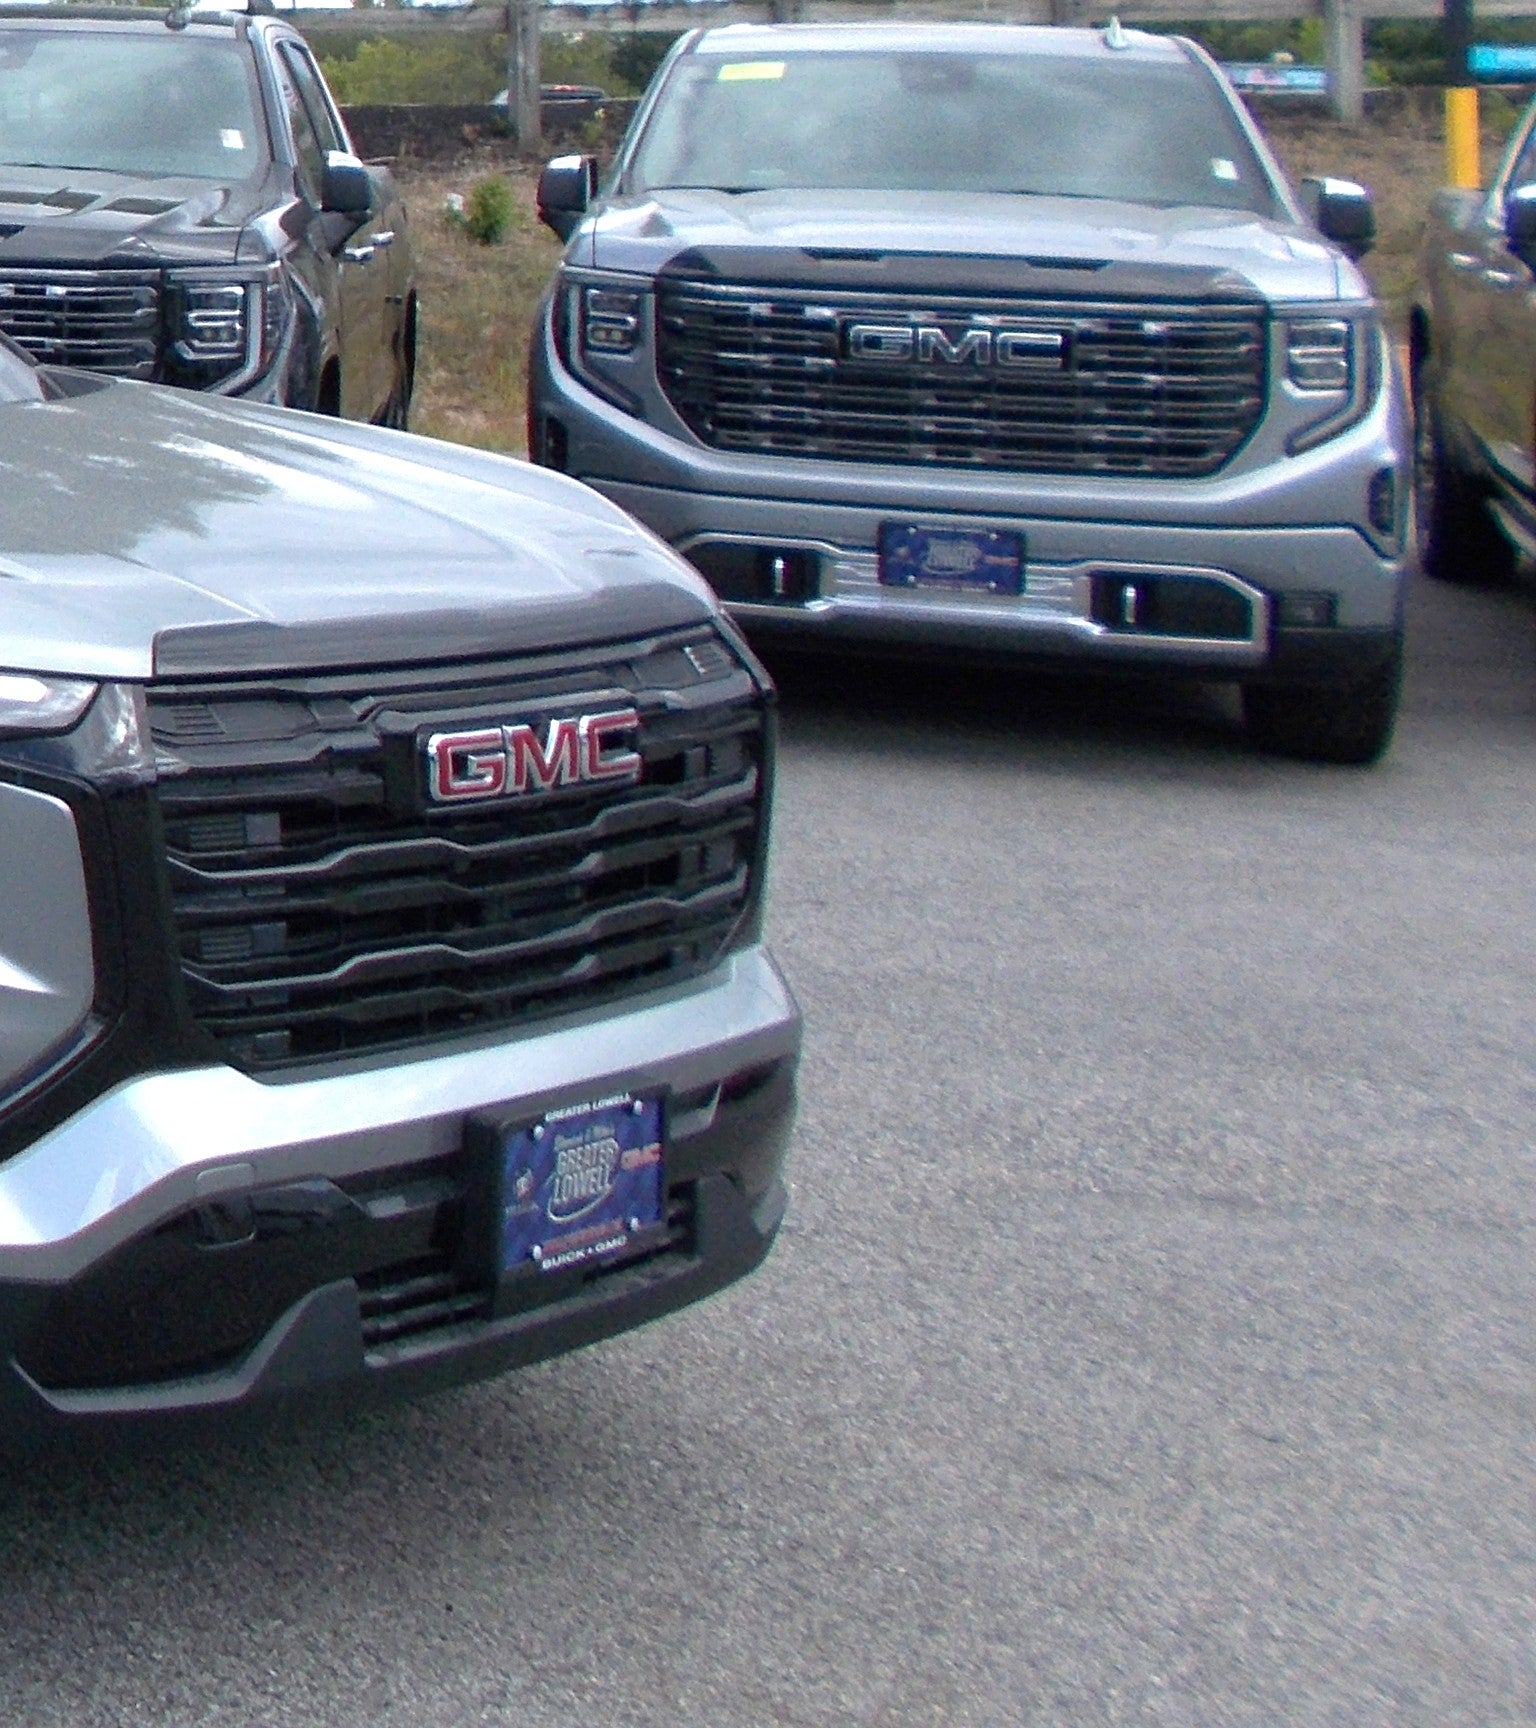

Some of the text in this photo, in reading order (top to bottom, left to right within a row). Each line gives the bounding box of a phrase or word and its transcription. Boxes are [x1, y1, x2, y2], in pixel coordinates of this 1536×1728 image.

[848, 324, 1063, 370] GMC
[428, 708, 642, 802] GMC
[545, 1102, 591, 1122] GREATER
[542, 1249, 585, 1270] BUICK
[595, 1235, 628, 1253] GMC
